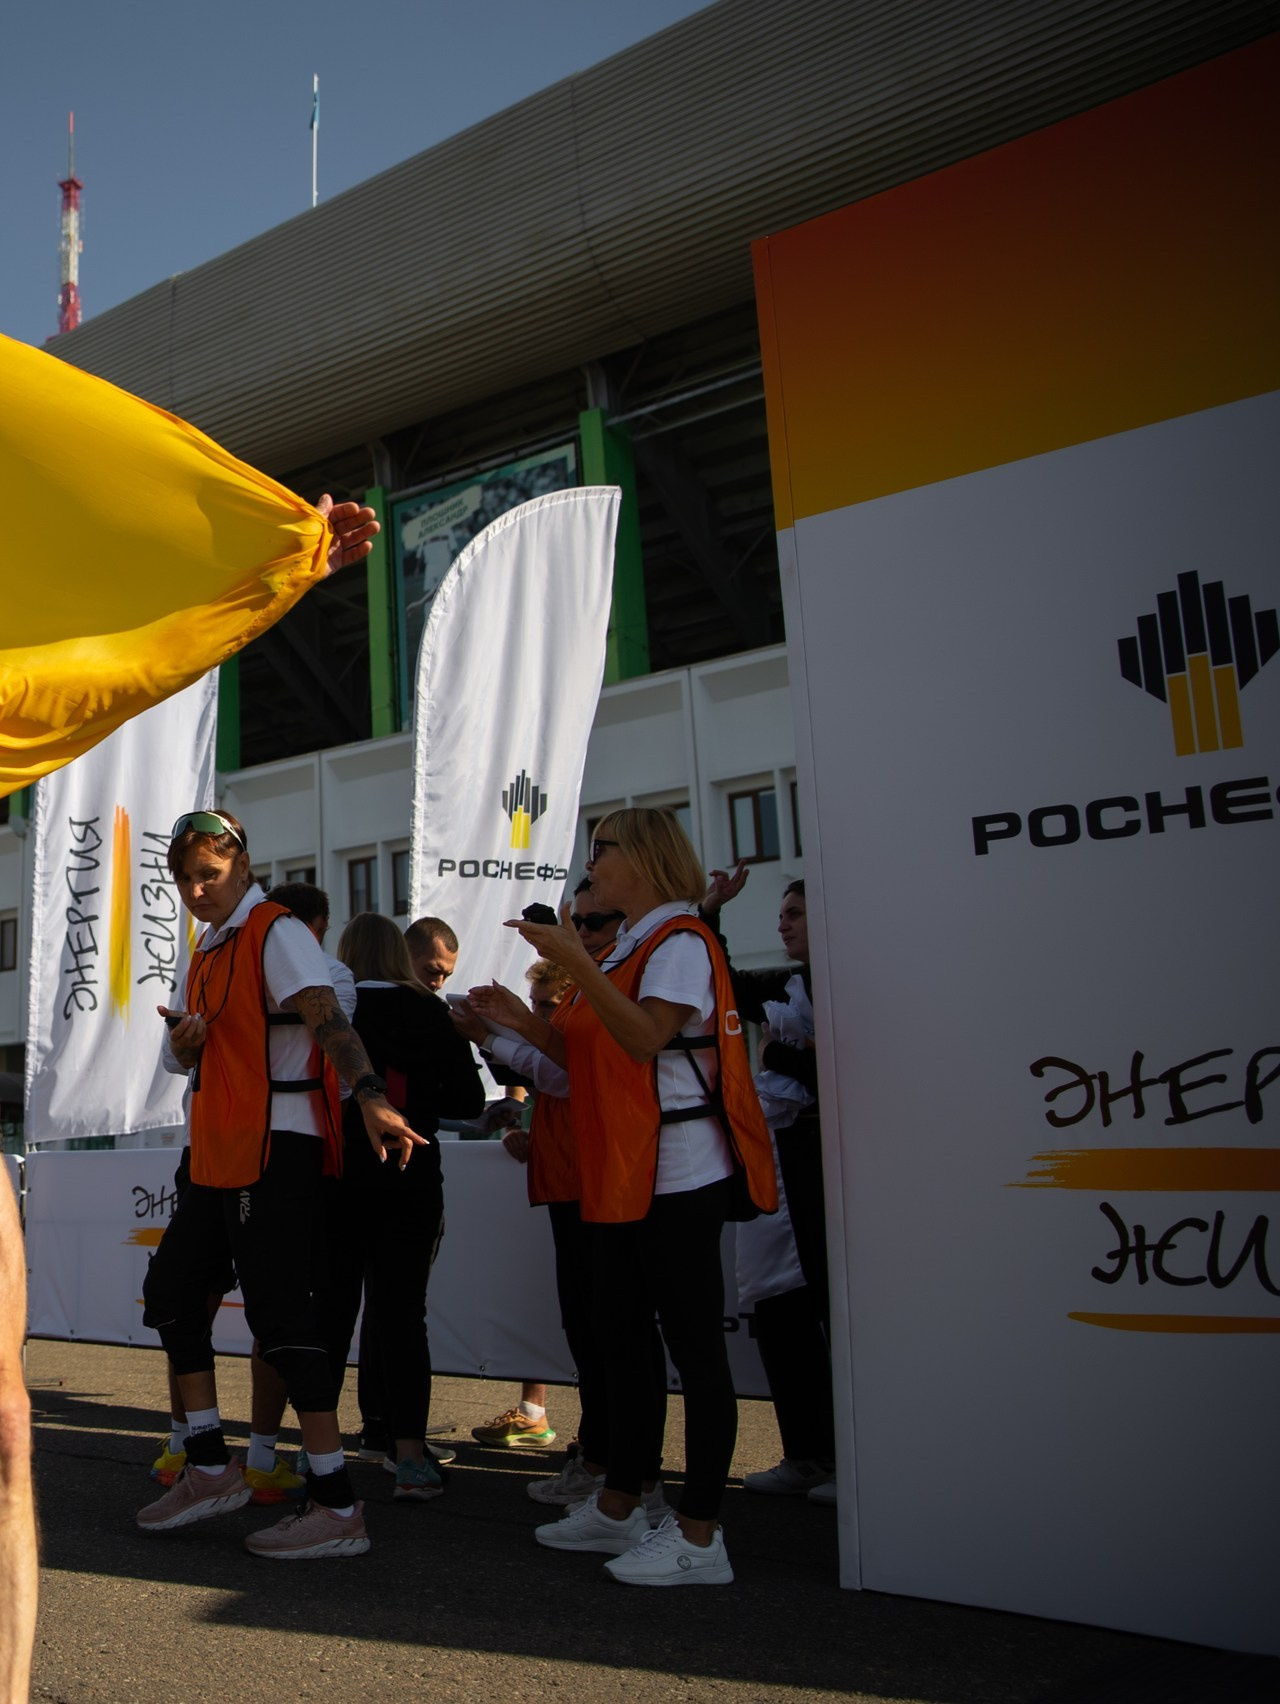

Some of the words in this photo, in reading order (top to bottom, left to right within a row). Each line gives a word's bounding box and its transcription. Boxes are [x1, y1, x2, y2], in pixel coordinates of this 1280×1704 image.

[971, 775, 1280, 857] РОСНЕ
[63, 815, 104, 1021] ЭНЕРГИЯ
[136, 831, 178, 993] ЖИЗНИ
